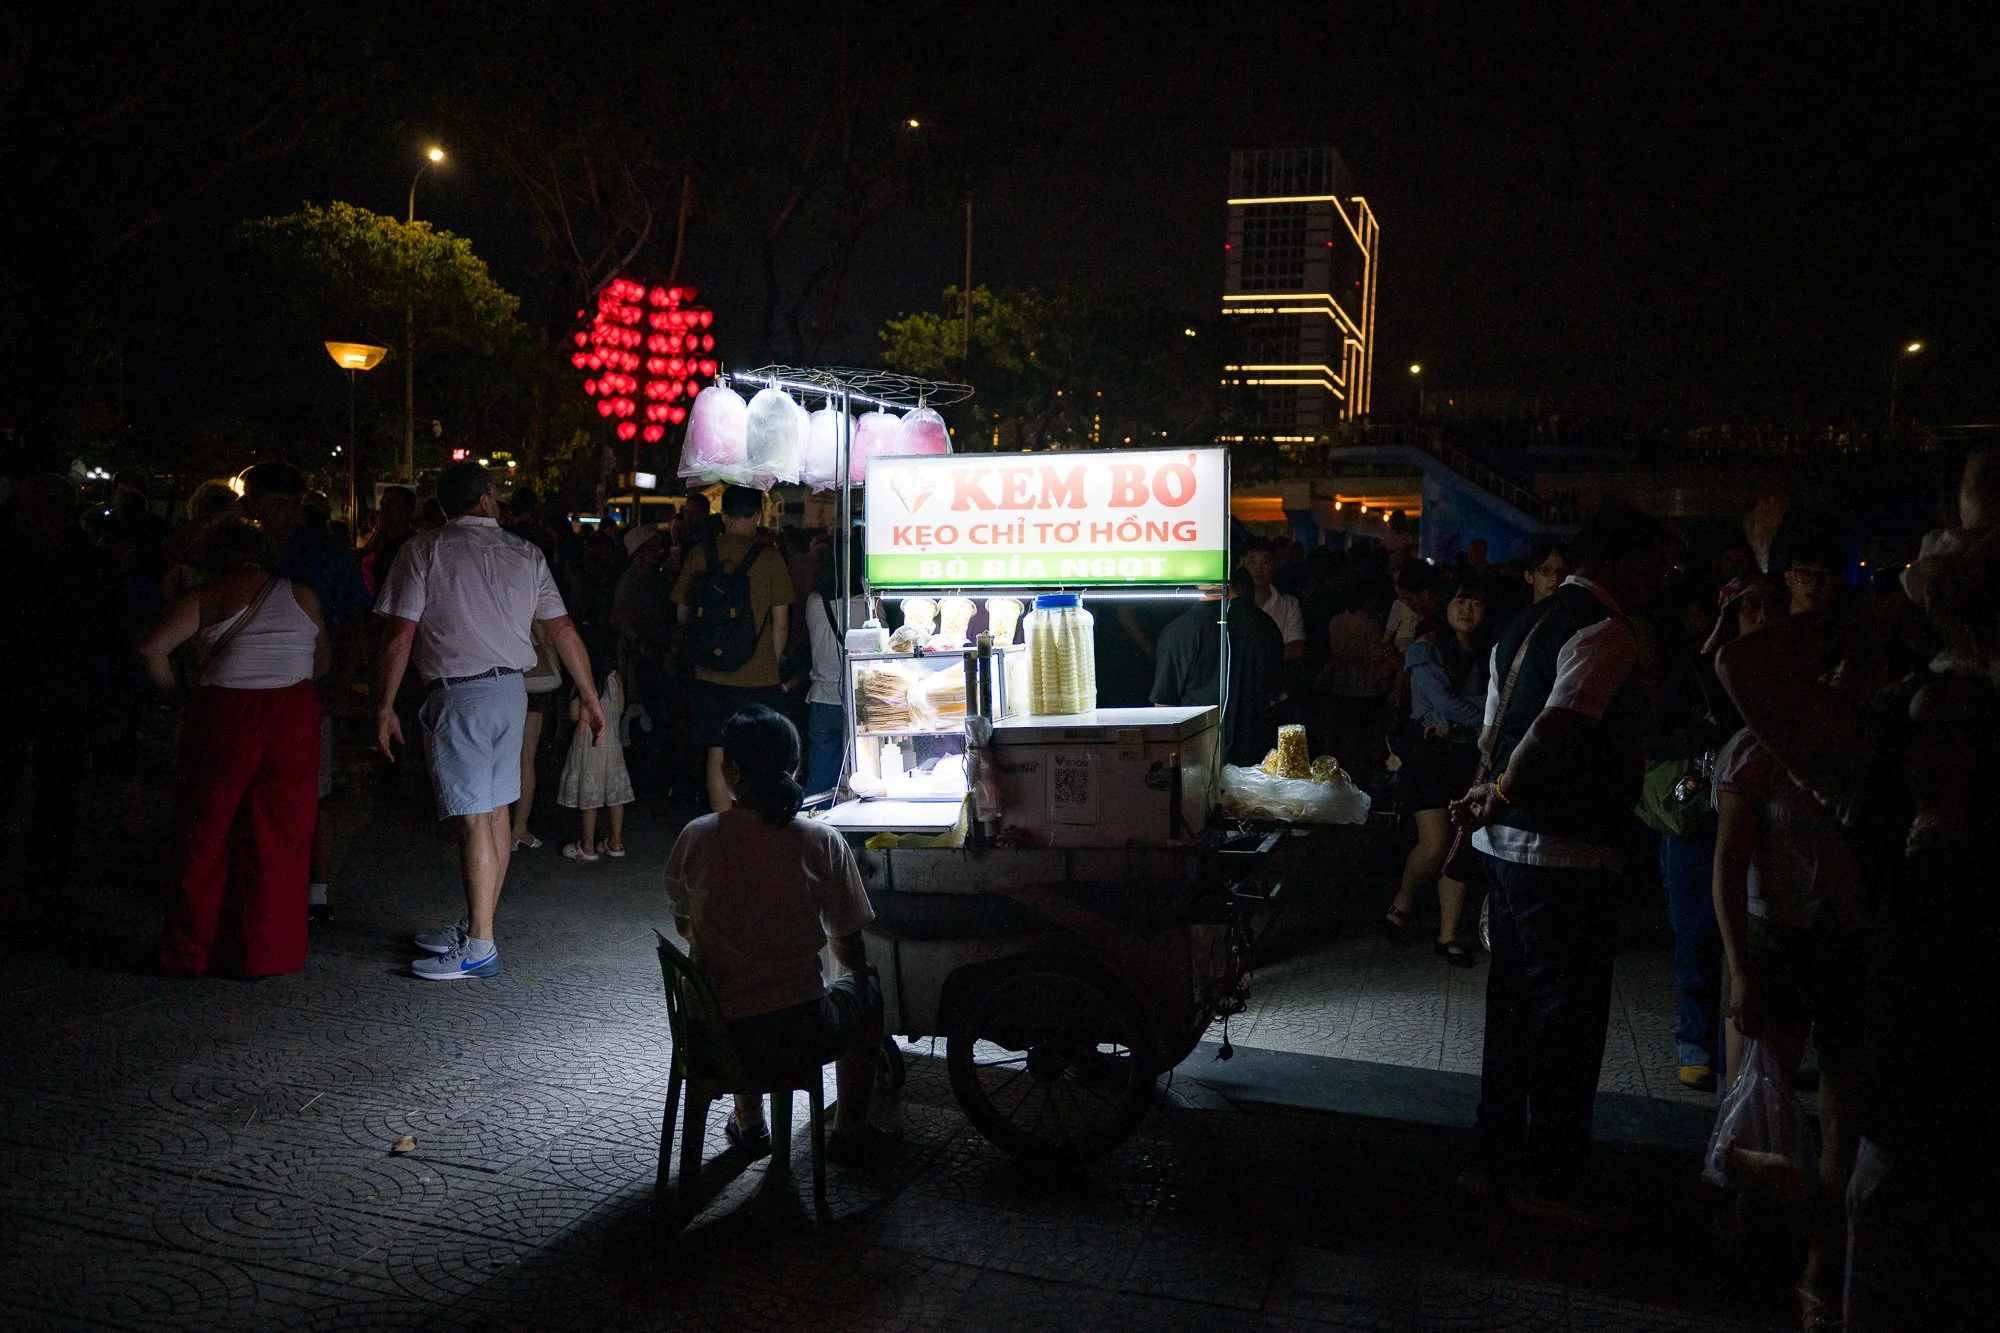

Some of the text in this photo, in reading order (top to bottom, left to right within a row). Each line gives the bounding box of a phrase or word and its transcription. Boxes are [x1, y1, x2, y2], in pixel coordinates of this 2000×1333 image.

[950, 453, 1198, 511] KEM BƠ
[892, 514, 1198, 551] KẸO CHỈ TƠ HỒNG
[919, 555, 1167, 582] BÒ BÍA NGỌT
